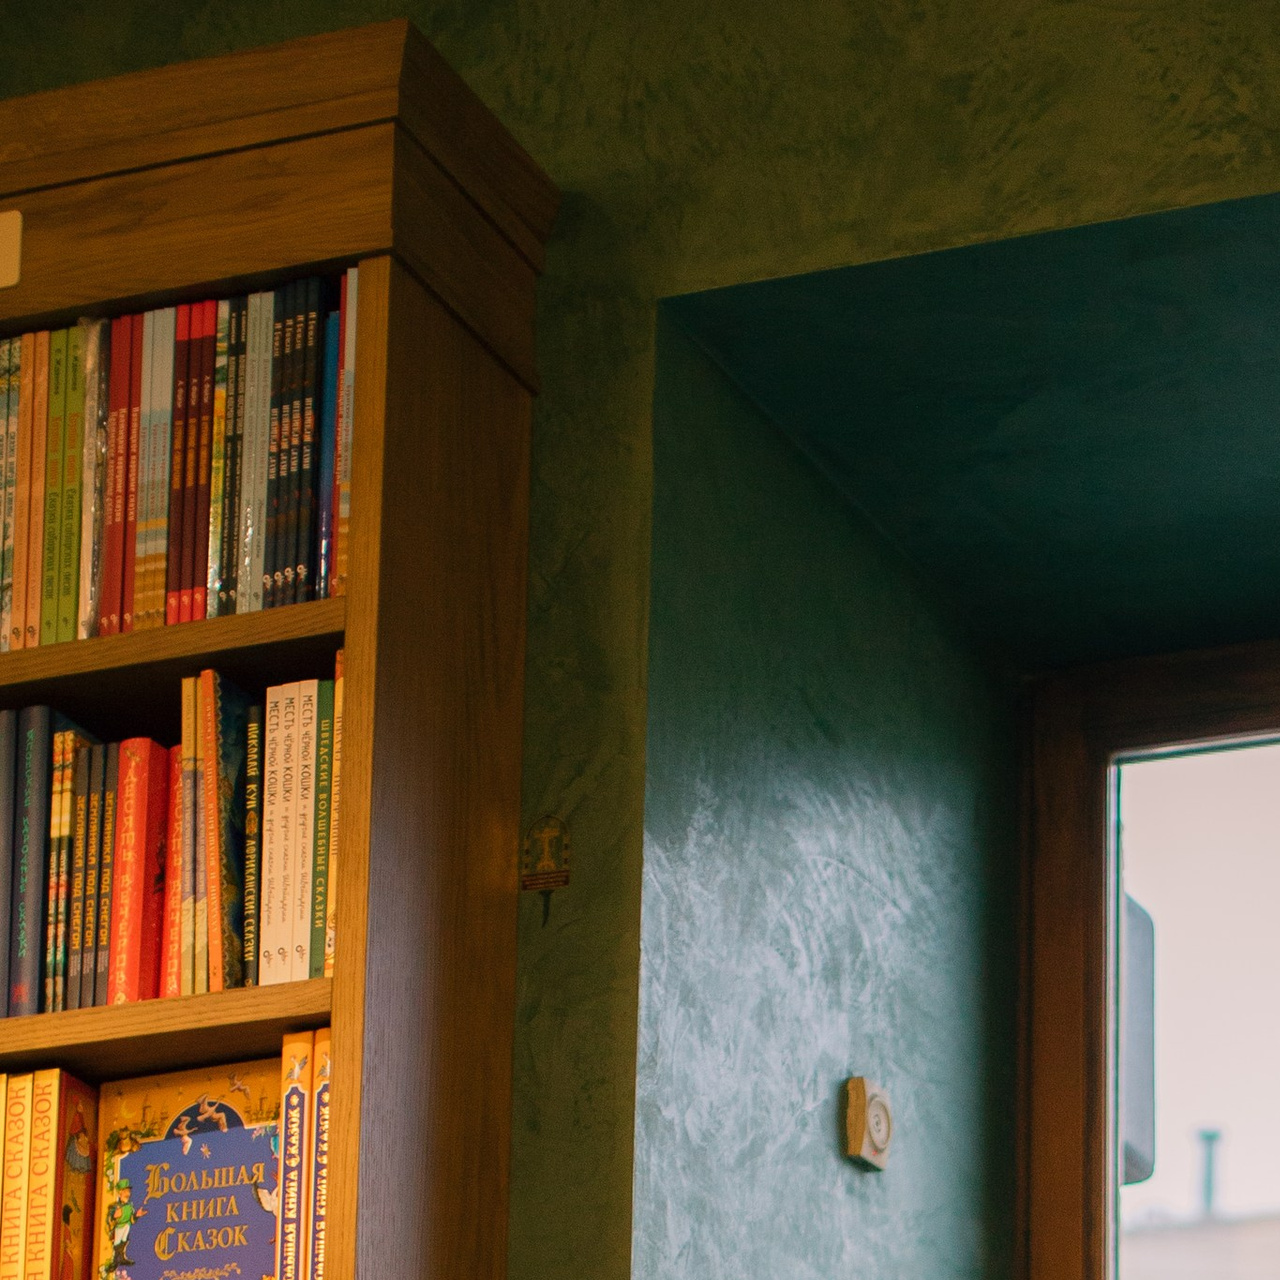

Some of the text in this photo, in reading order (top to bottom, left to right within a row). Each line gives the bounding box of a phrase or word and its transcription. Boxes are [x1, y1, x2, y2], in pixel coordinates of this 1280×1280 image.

[269, 701, 280, 734] МЕСТЬ
[284, 697, 295, 730] МЕСТЬ
[301, 694, 313, 727] МЕСТЬ
[266, 769, 278, 805] КОШКИ
[282, 766, 294, 802] КОШКИ
[300, 764, 312, 800] КОШКИ
[75, 795, 85, 867] ЗЕМЛЯНИКА
[88, 792, 99, 865] ЗЕМЛЯНИКА
[103, 791, 114, 864] ЗЕМЛЯНИКА
[243, 723, 259, 962] НИКОЛАЙ КУН АФРИКАНСКИЕ СКАЗКИ
[314, 719, 330, 928] ШВЕДСКИЕ ВОЛШЕБНЫЕ СКАЗКИ
[73, 873, 83, 898] ПОД
[86, 870, 96, 896] ПОД
[101, 868, 112, 895] ПОД
[71, 902, 82, 949] СНЕГОМ
[85, 899, 95, 947] СНЕГОМ
[99, 898, 110, 946] СНЕГОМ
[6, 1086, 27, 1180] СКАЗОК
[32, 1083, 53, 1177] СКАЗОК
[166, 1195, 239, 1223] КНИГА
[285, 1170, 298, 1219] КНИГА
[1, 1185, 23, 1265] КНИГА
[27, 1182, 49, 1262] КНИГА
